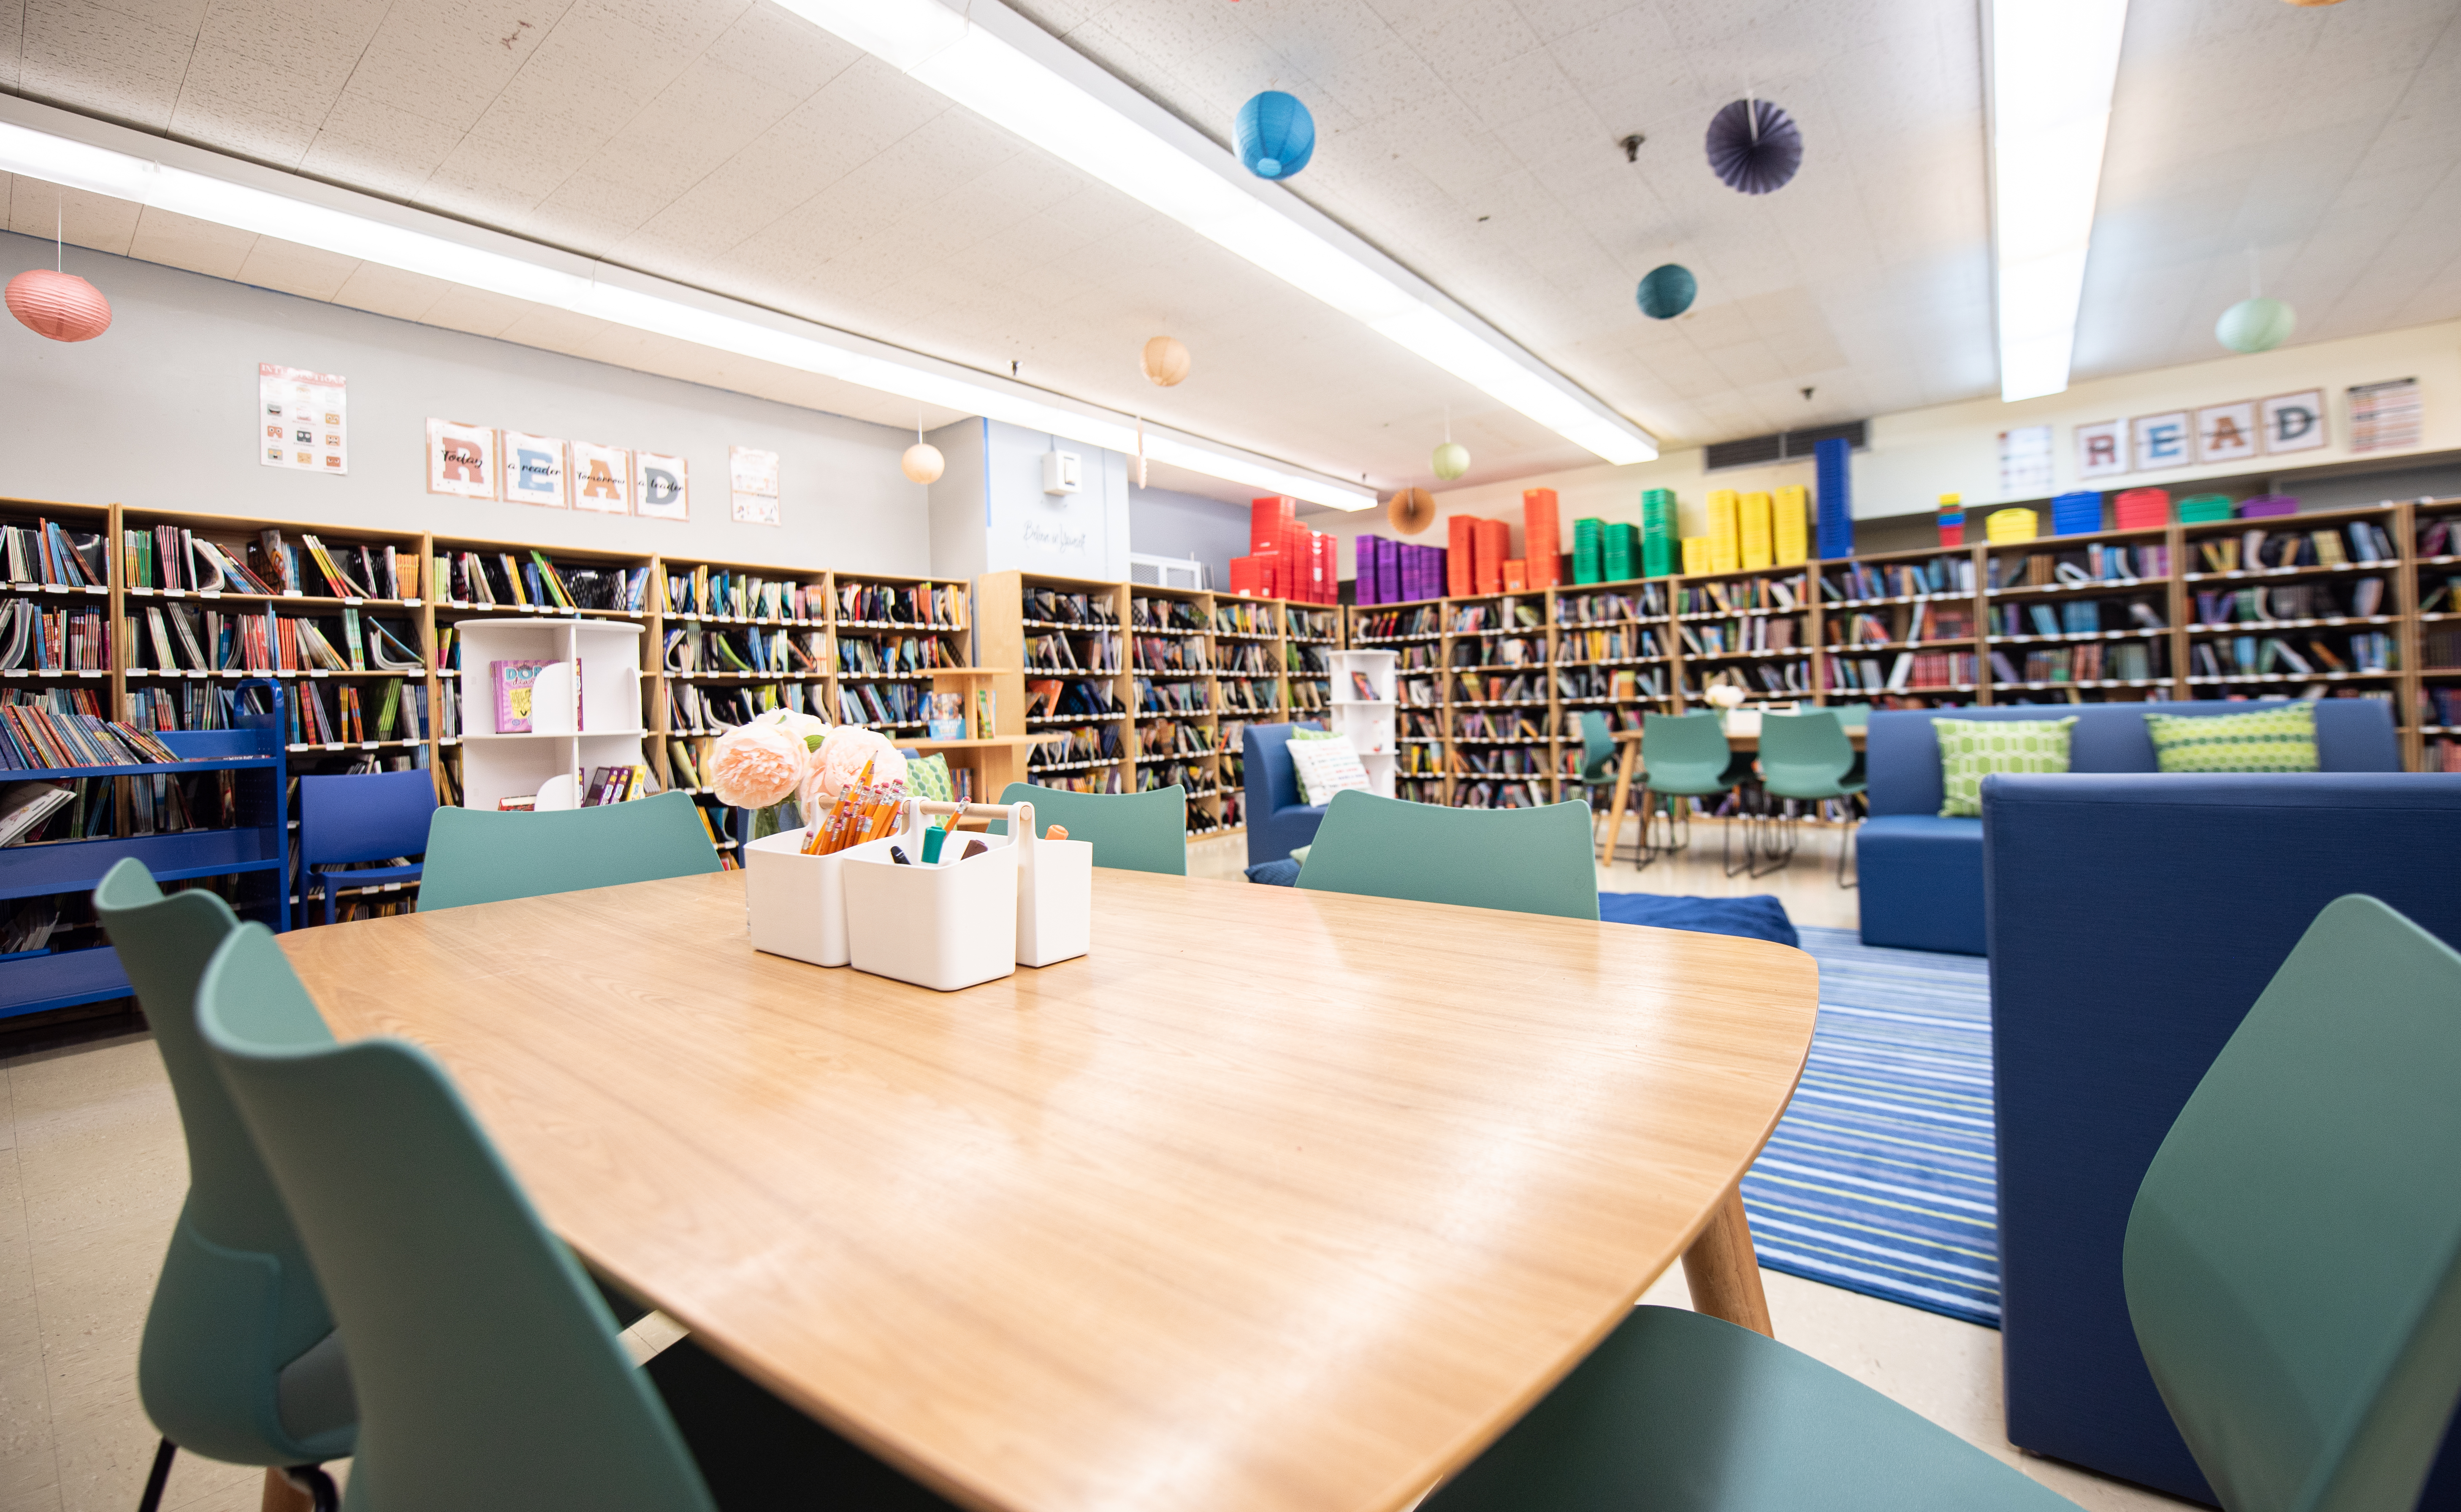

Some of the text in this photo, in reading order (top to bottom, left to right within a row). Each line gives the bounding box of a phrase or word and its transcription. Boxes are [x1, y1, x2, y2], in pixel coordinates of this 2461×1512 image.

[262, 364, 345, 384] INTEECTIONS
[2087, 407, 2314, 466] READ
[442, 450, 483, 469] Today
[522, 465, 561, 476] reader
[577, 471, 625, 484] Tomorrow
[651, 479, 684, 493] leader
[443, 437, 679, 505] READ
[506, 665, 543, 680] DOR
